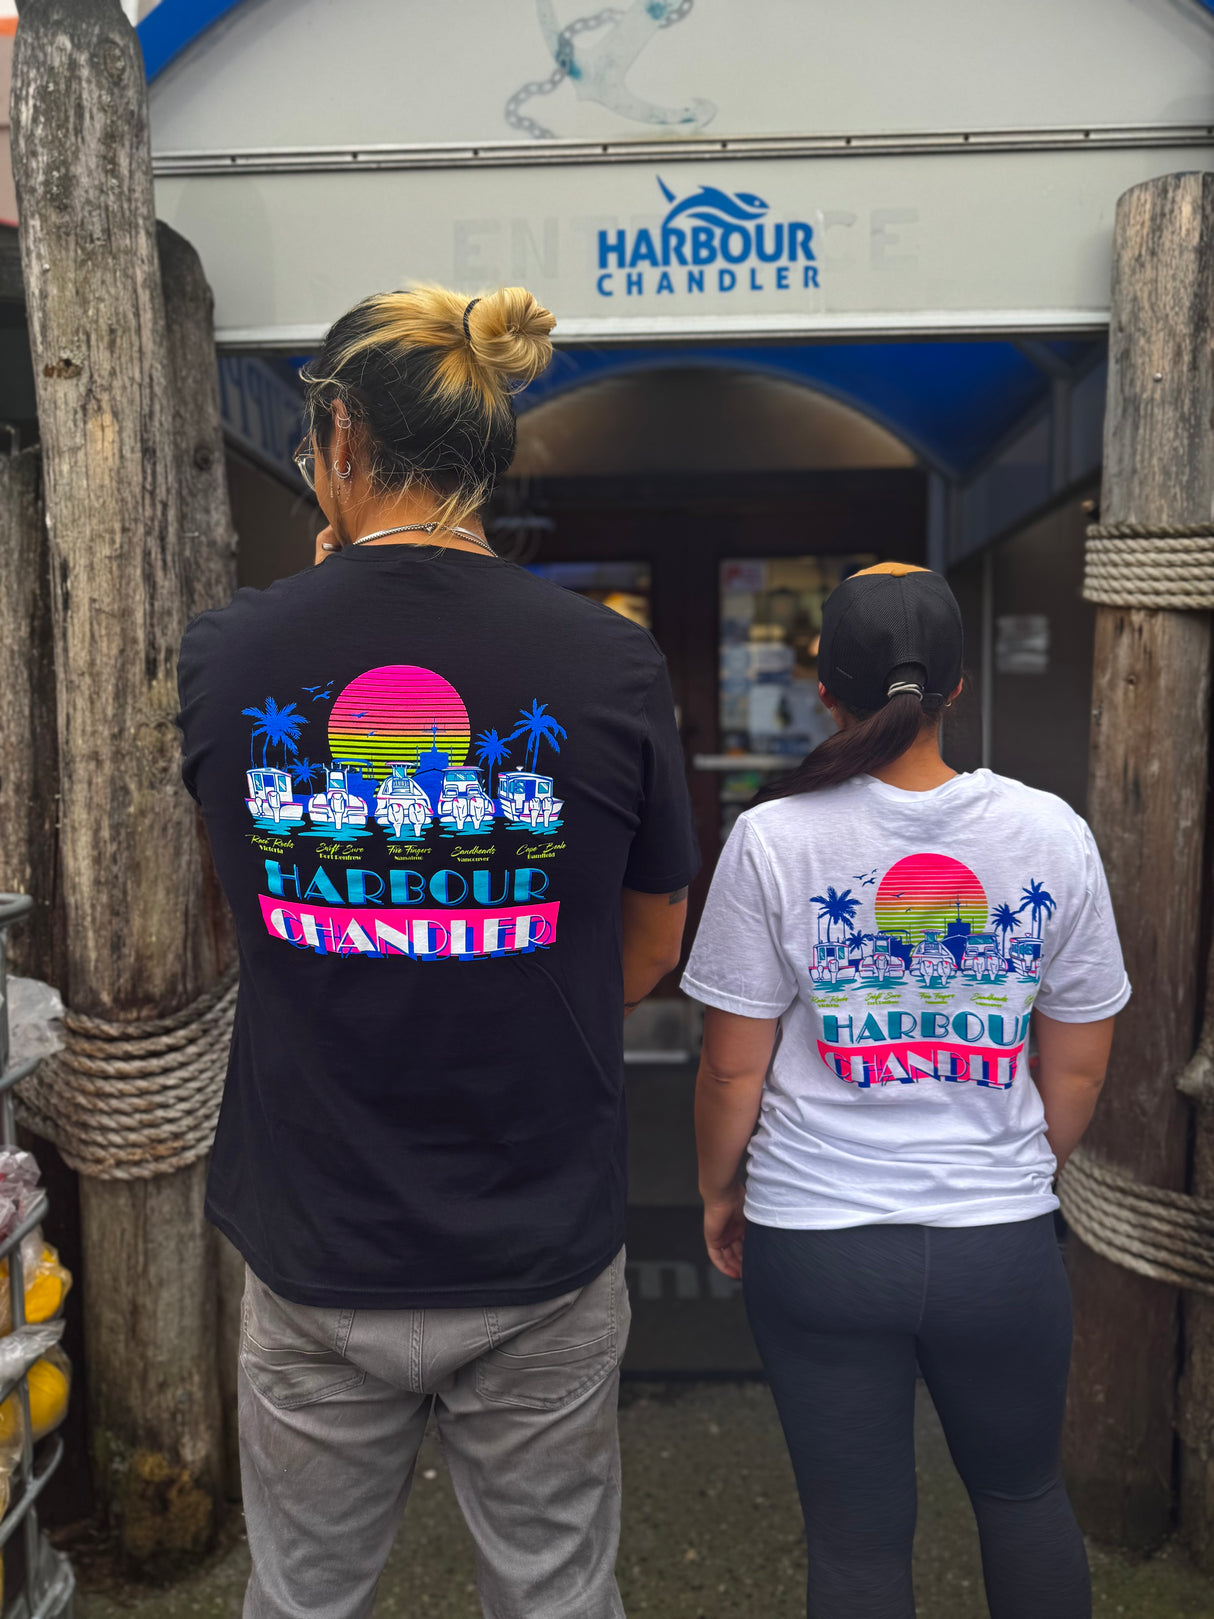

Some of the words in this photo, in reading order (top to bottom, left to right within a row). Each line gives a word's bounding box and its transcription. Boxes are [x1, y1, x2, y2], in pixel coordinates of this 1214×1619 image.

[452, 208, 919, 282] ENTCE
[598, 221, 816, 269] HARBOUR
[596, 266, 820, 297] CHANDLER
[264, 859, 550, 906] HARBOUR
[270, 908, 552, 960] CHANDLER
[824, 1050, 1019, 1089] CHANDLE
